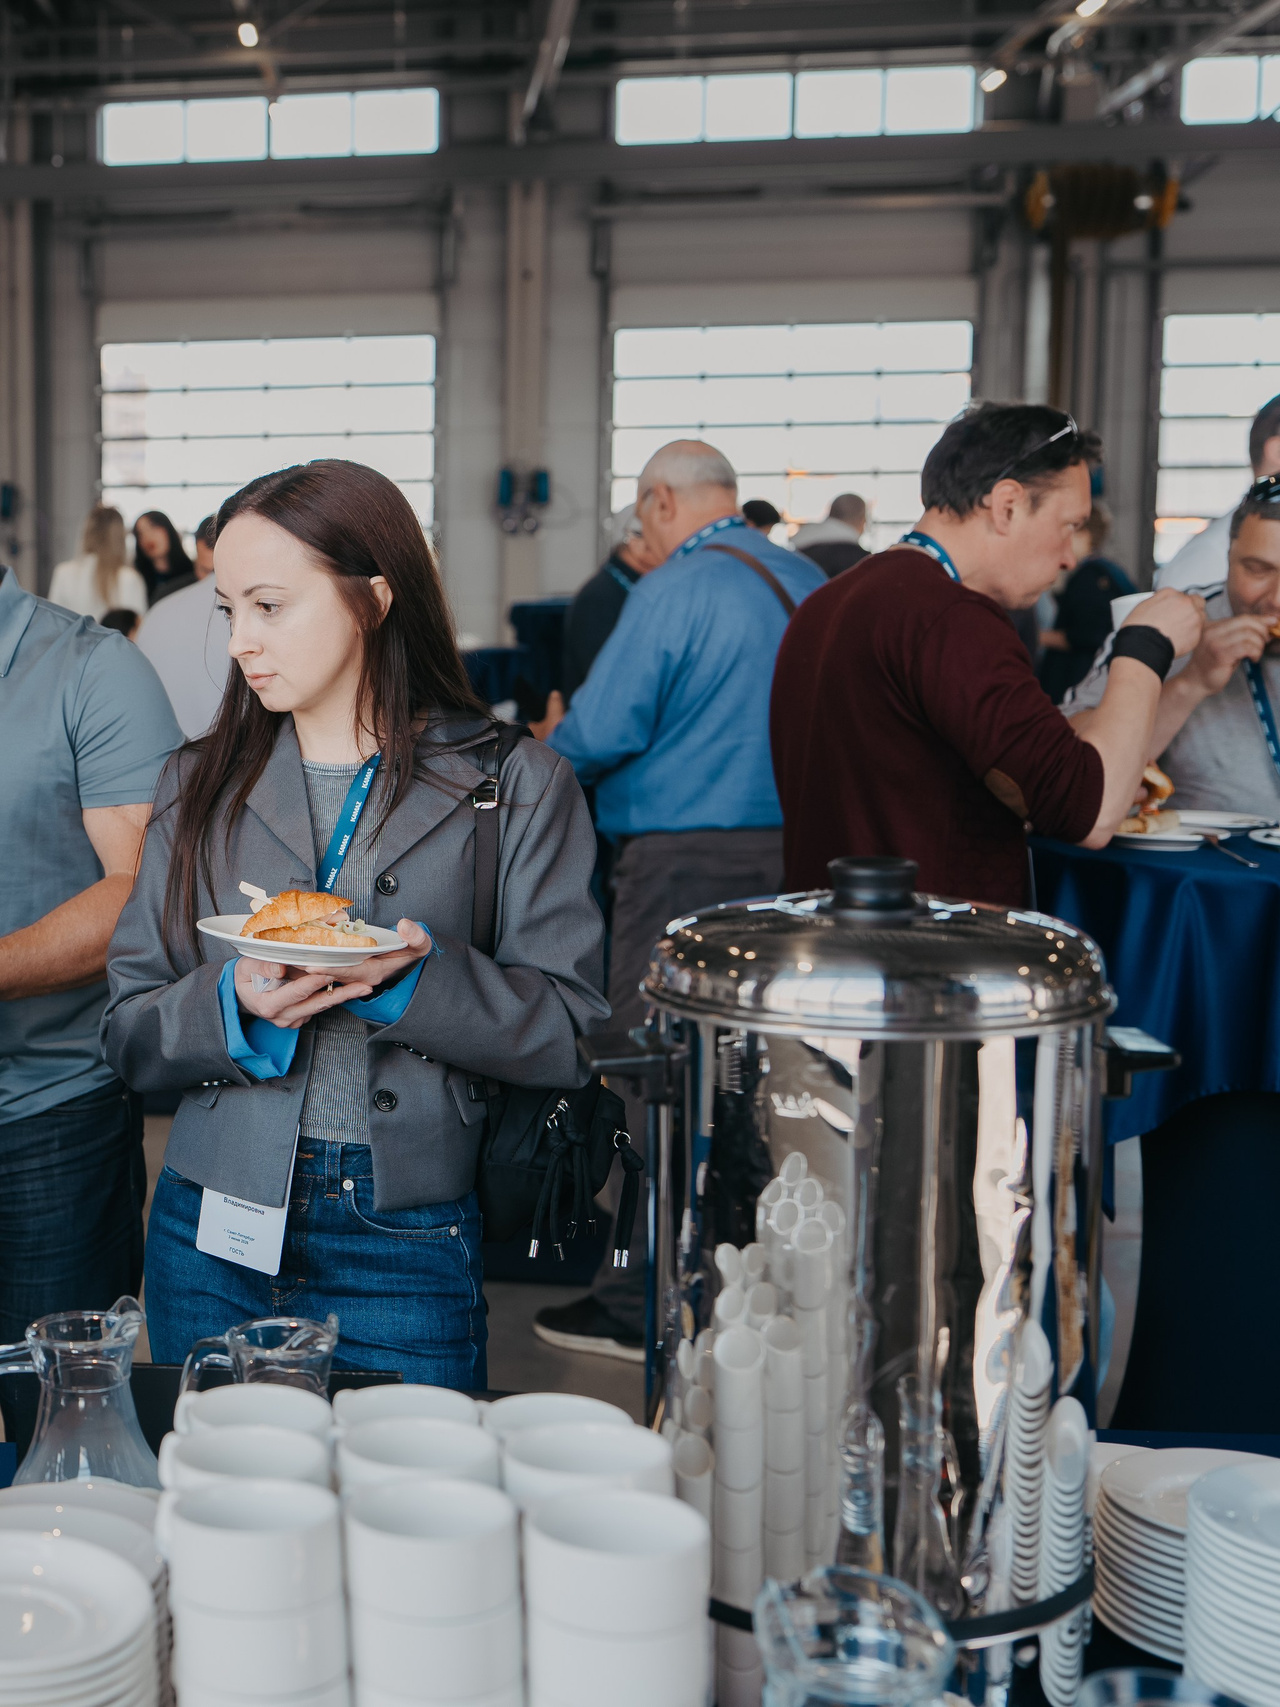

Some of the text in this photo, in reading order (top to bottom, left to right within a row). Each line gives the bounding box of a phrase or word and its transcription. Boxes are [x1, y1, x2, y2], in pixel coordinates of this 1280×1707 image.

[361, 768, 373, 789] KAMAZ
[350, 801, 362, 822] KAMAZ
[337, 834, 350, 856] KAMAZ
[325, 867, 338, 889] KAMAZ
